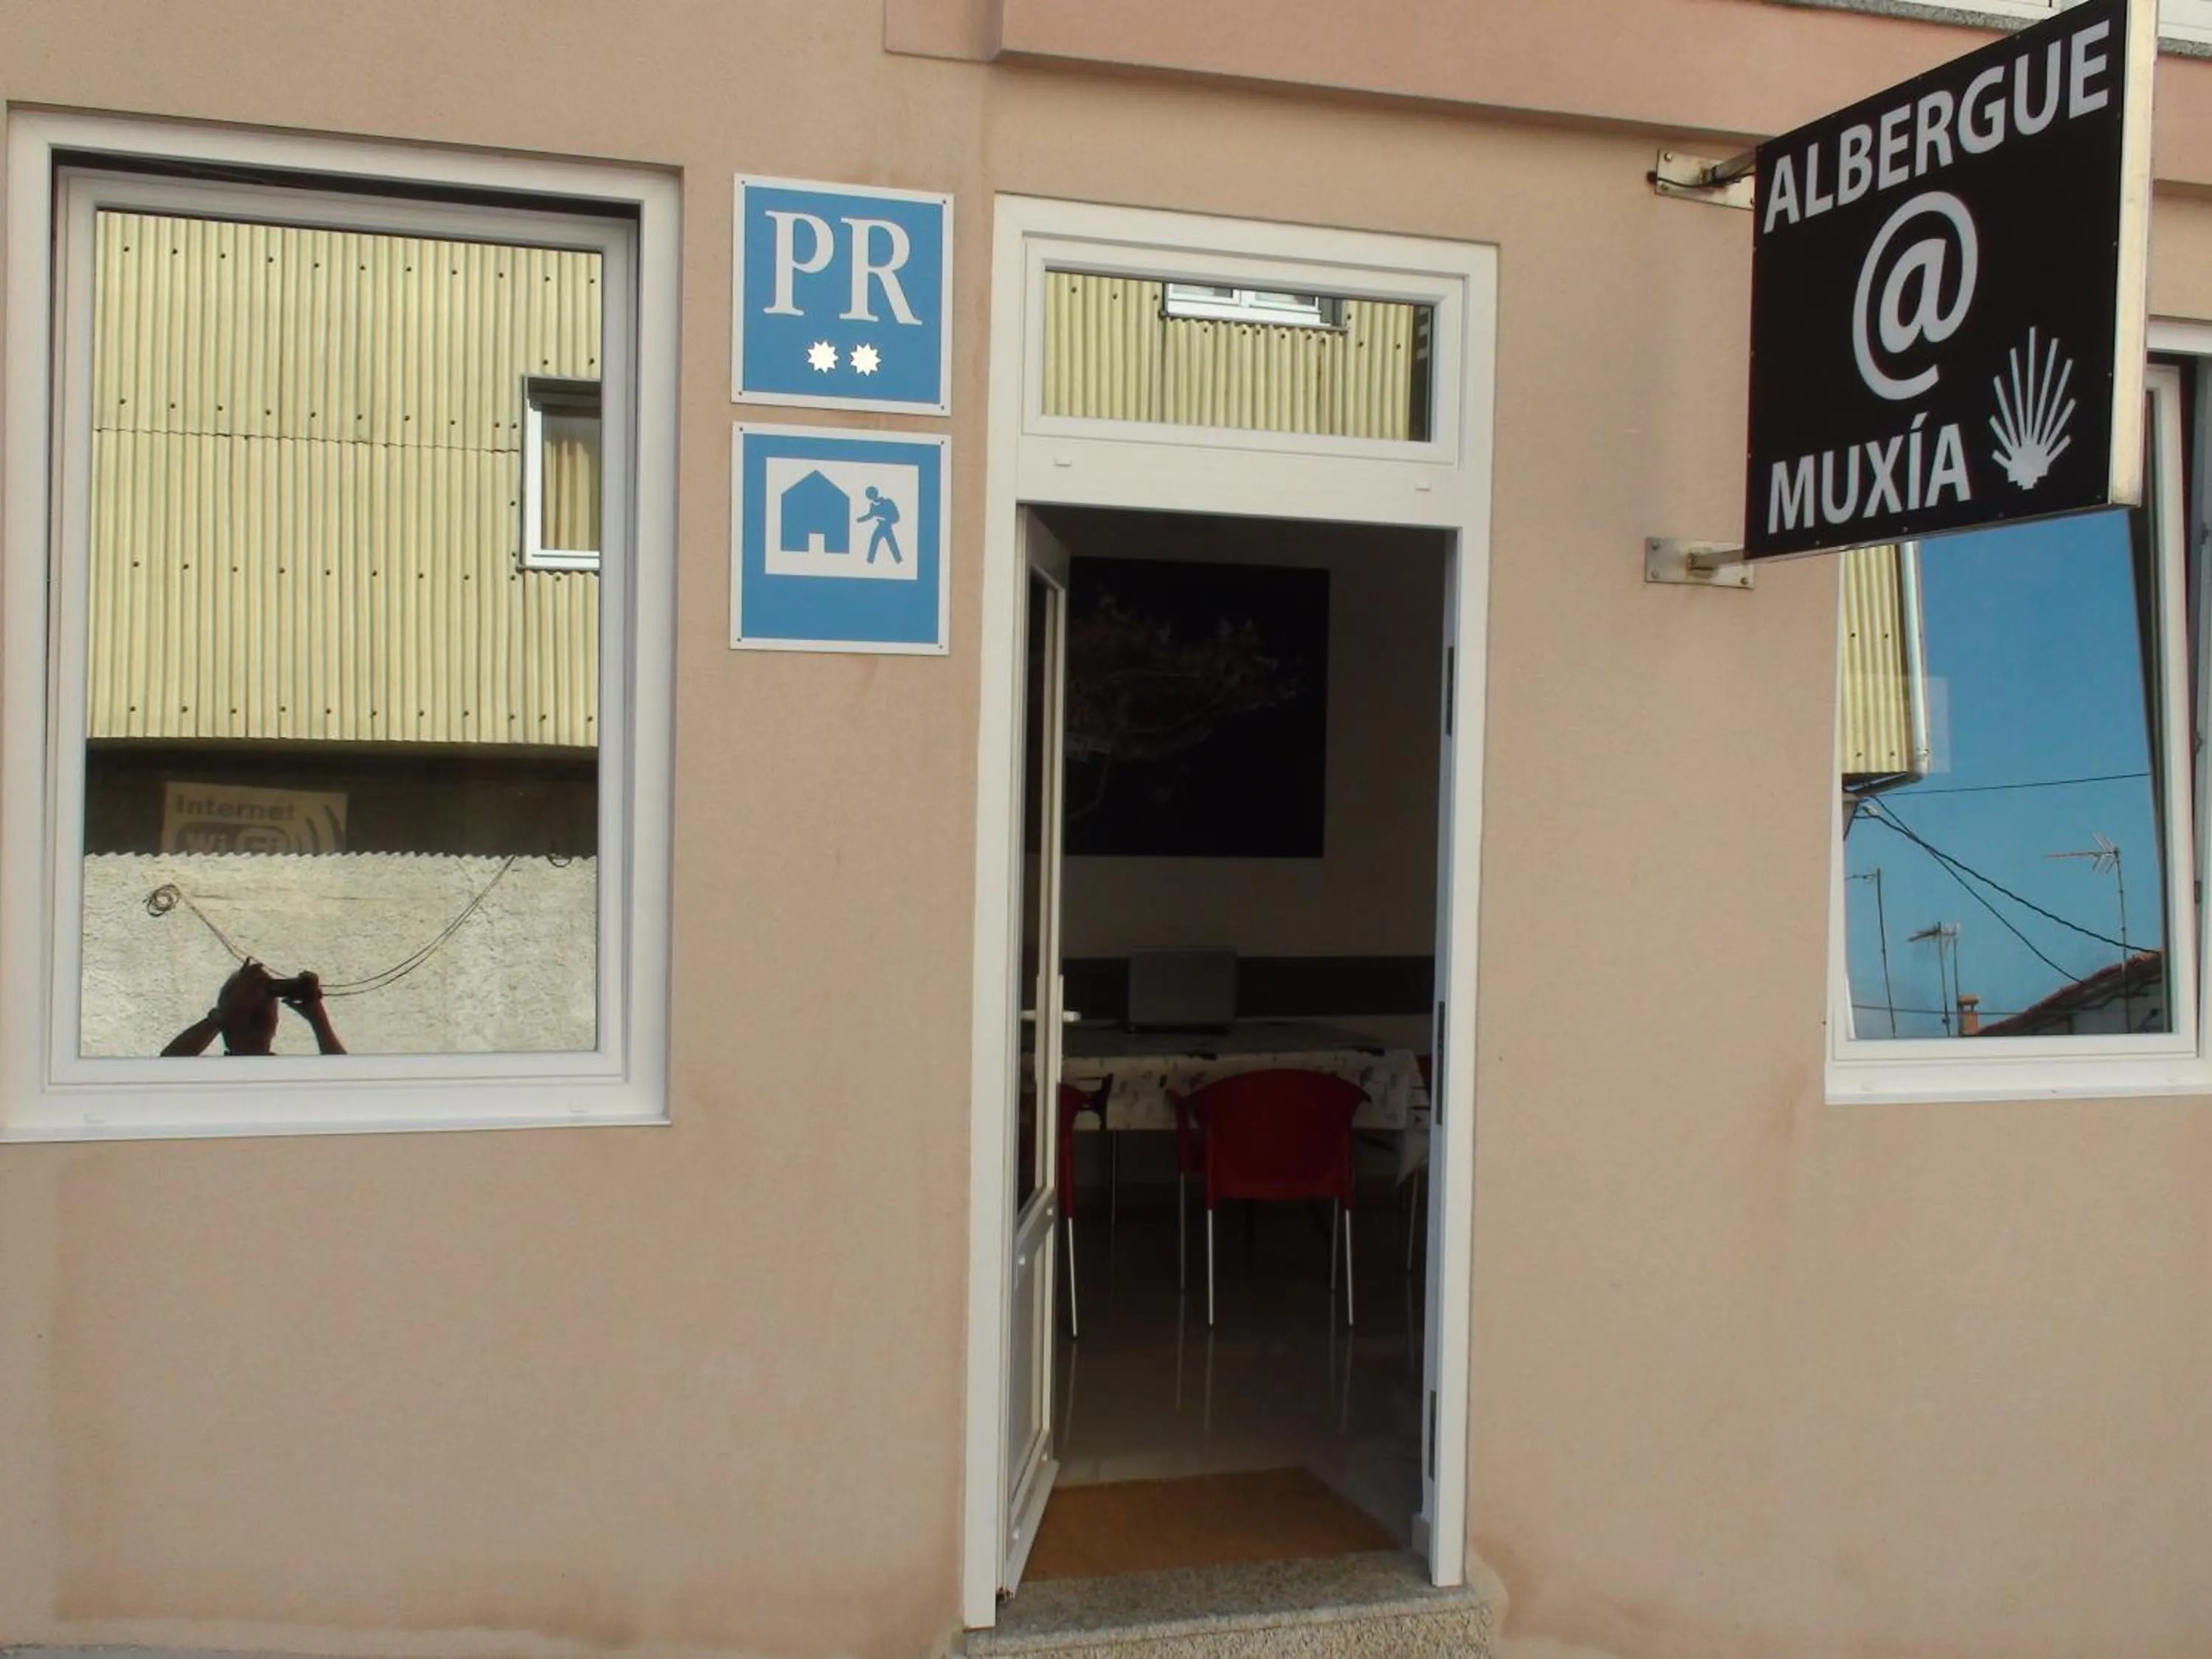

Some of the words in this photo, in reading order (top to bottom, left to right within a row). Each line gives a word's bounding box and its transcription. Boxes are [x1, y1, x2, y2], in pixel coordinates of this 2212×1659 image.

[1763, 19, 2110, 234] ALBERGUE
[763, 210, 922, 325] PR
[1852, 191, 1978, 400] @
[1767, 412, 1971, 535] MUXÍA
[175, 795, 296, 821] Internet
